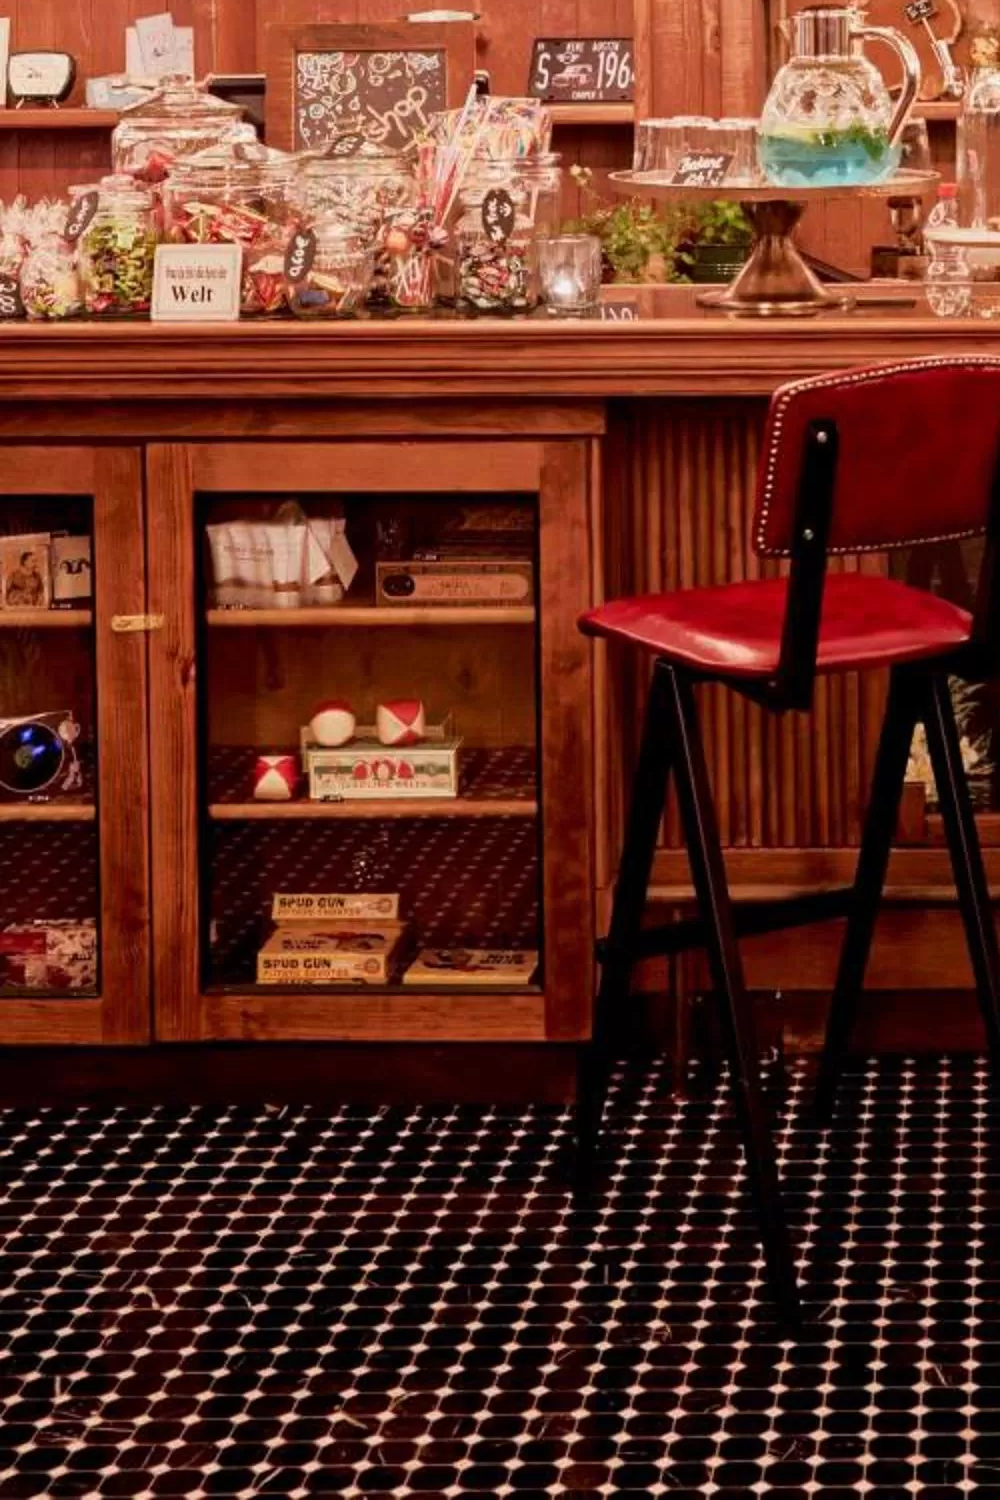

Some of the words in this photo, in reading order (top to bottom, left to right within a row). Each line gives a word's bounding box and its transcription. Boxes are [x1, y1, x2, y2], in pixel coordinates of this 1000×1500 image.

[171, 285, 213, 303] Welt
[317, 897, 345, 909] GUN
[263, 959, 299, 969] SPUD
[303, 958, 331, 969] GUN
